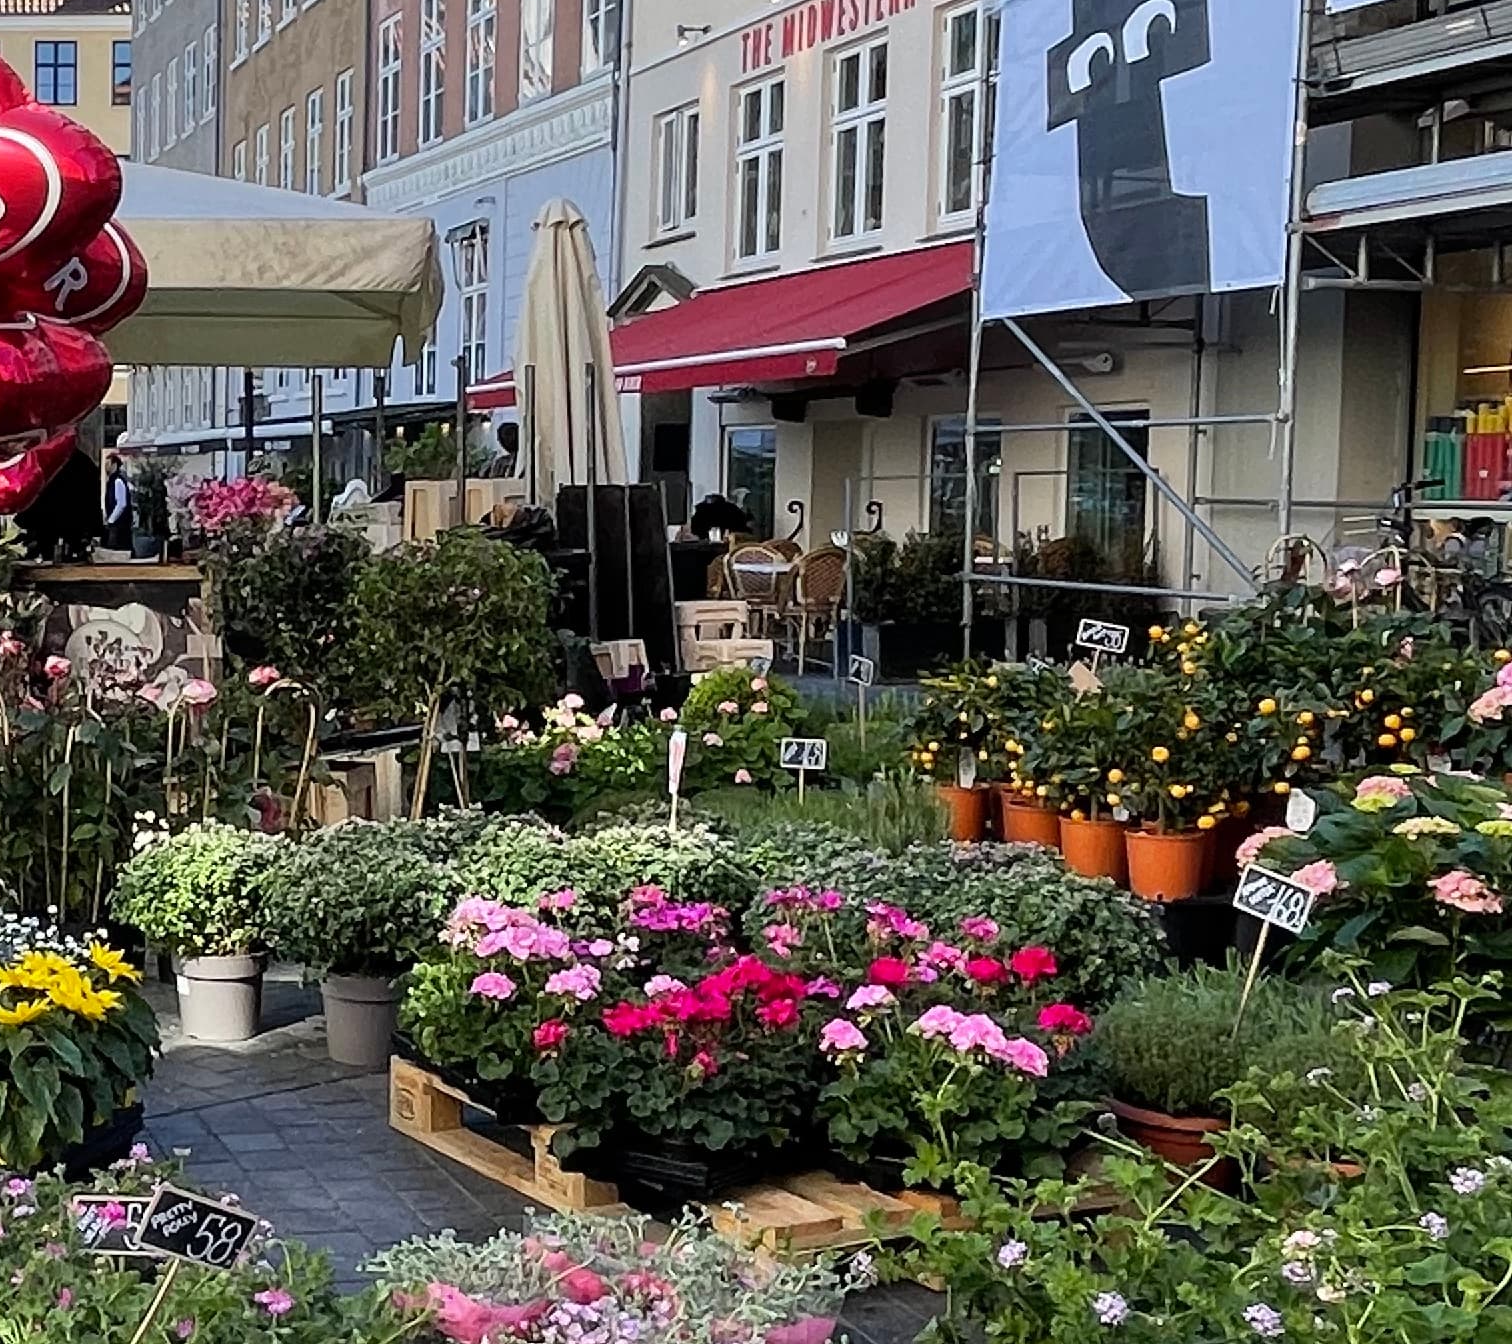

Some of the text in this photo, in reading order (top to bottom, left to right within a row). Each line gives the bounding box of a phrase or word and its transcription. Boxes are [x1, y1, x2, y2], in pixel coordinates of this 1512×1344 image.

[741, 23, 773, 74] THE
[150, 1200, 193, 1230] PRETTY
[162, 1211, 198, 1238] POLLY
